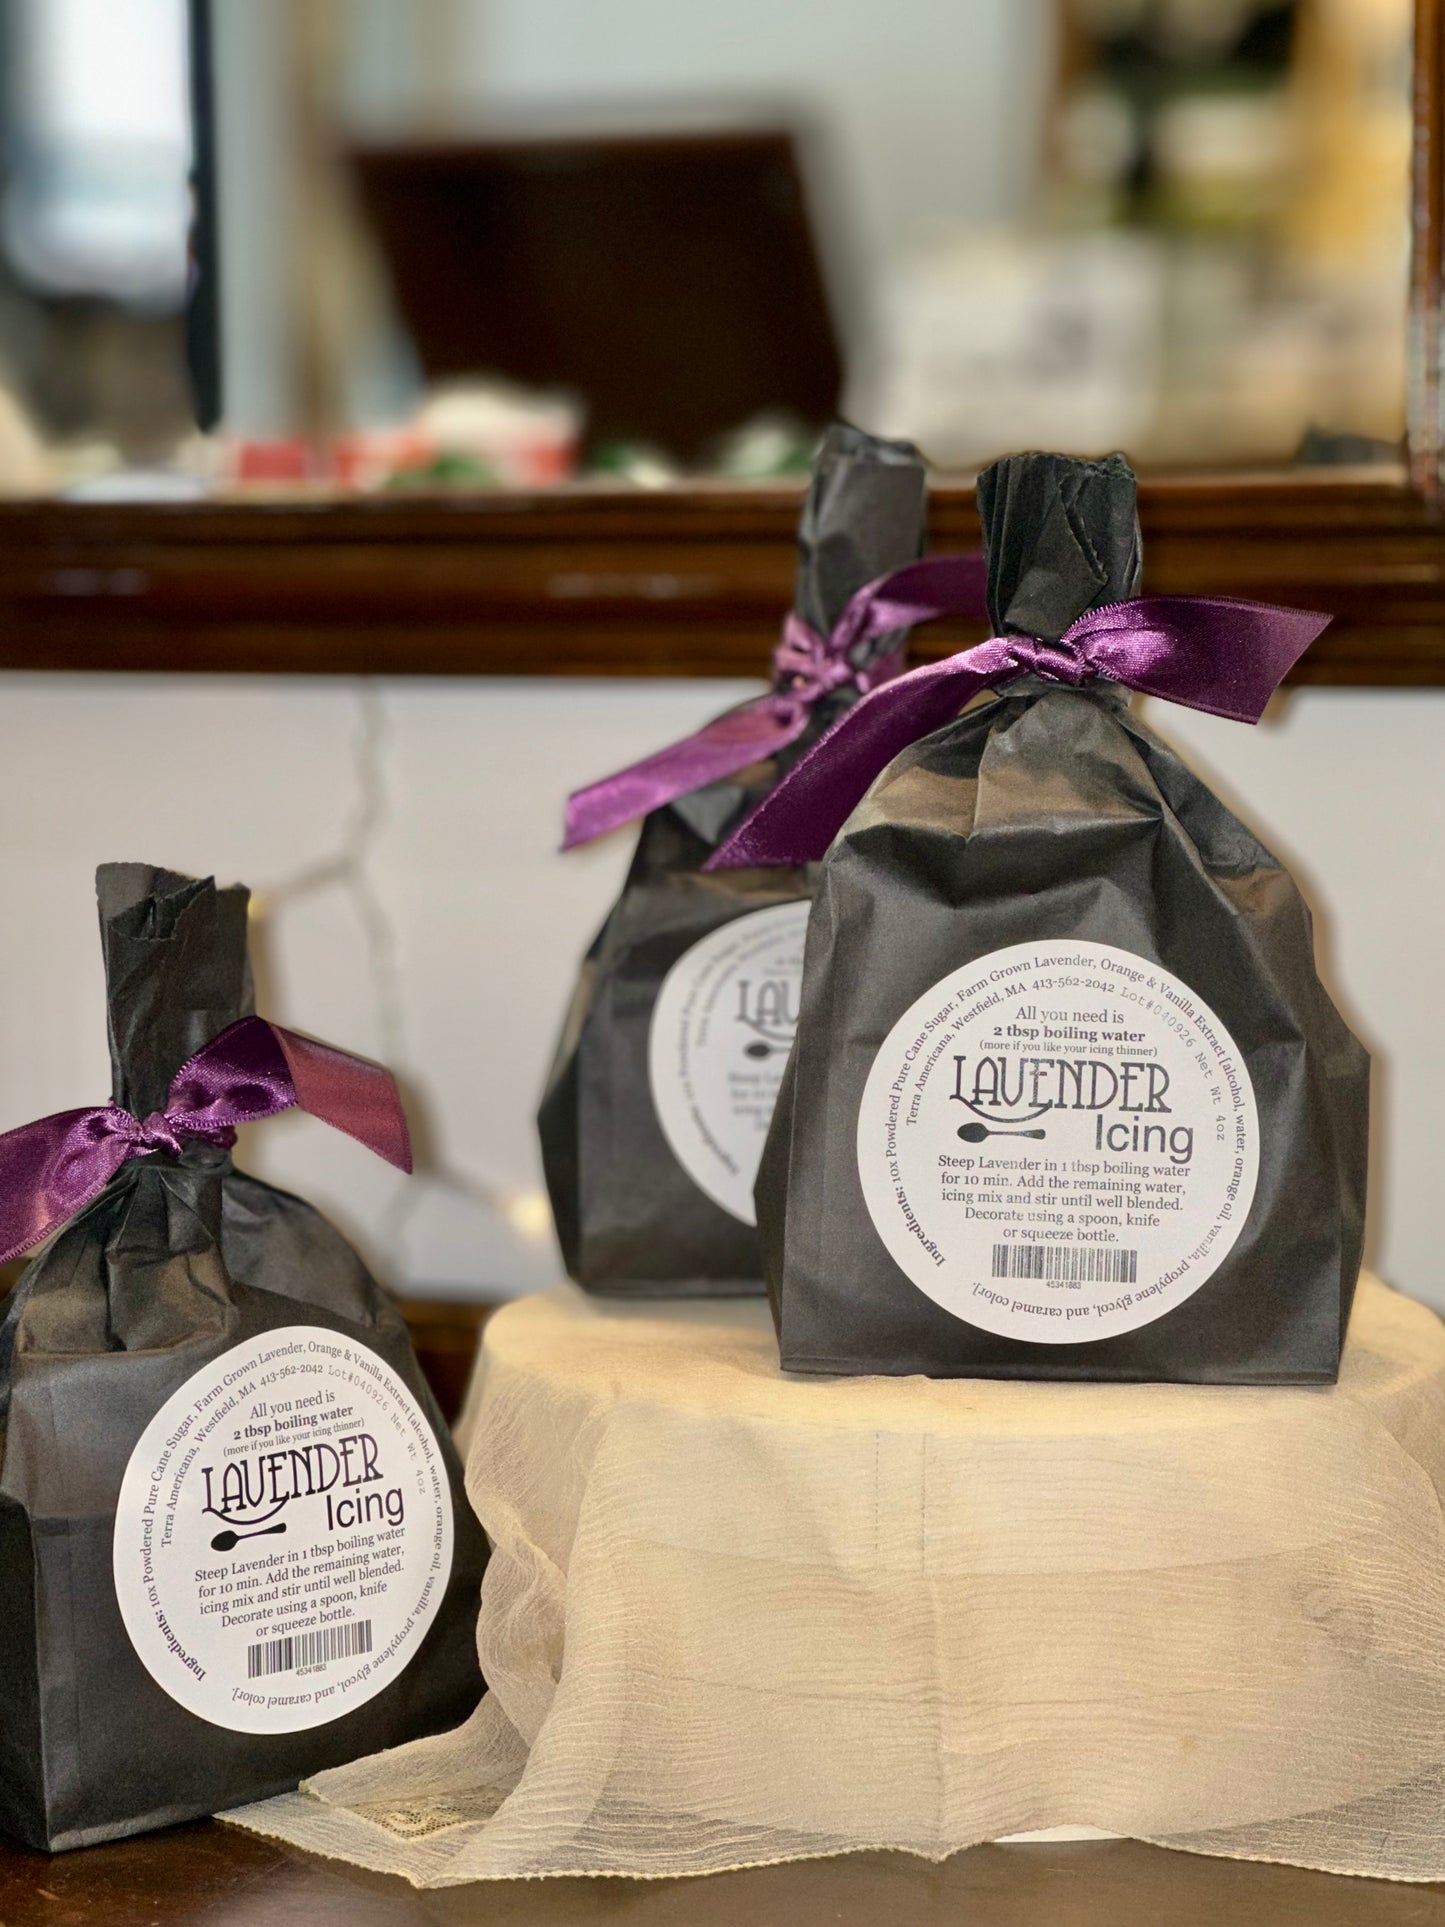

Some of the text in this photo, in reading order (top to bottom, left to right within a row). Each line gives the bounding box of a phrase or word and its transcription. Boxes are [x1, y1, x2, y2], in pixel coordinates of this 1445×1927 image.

[990, 962, 1031, 982] Grown
[1034, 955, 1096, 968] Lavender,
[1101, 958, 1145, 983] Orange
[957, 979, 989, 1002] Farm
[1146, 977, 1157, 989] &
[1016, 1006, 1124, 1024] All you need is
[1160, 983, 1194, 1018] Vanilla
[924, 1001, 959, 1032] Sugar,
[905, 1031, 928, 1061] Cane
[980, 1040, 1158, 1057] (more if you like your icing thinner)
[994, 1025, 1145, 1043] 2 tbsp boiling water
[1194, 1014, 1226, 1058] Extract
[906, 1092, 921, 1126] Terra
[914, 1033, 955, 1092] Americana,
[951, 992, 1004, 1031] Westfield,
[1005, 982, 1027, 997] MA
[1032, 976, 1115, 992] 413-562-2042
[1195, 1052, 1212, 1079] Net
[1210, 1086, 1222, 1105] Wt
[892, 1063, 911, 1091] Pure
[950, 1056, 1172, 1123] LAVENDER
[885, 1094, 899, 1158] Powdered
[1096, 1114, 1193, 1164] Icing
[1235, 1114, 1247, 1154] water,
[938, 1155, 974, 1170] Steep
[979, 1156, 1041, 1171] Lavender
[1044, 1159, 1057, 1171] in
[1071, 1160, 1100, 1175] tbsp
[1104, 1161, 1149, 1177] boiling
[1153, 1166, 1191, 1176] water
[1227, 1158, 1244, 1201] orange
[941, 1172, 960, 1184] for
[983, 1176, 1012, 1186] min.
[1017, 1176, 1044, 1187] Add
[1048, 1176, 1069, 1188] the
[1073, 1179, 1141, 1194] remaining
[1145, 1183, 1186, 1195] water,
[942, 1189, 1183, 1210] icing mix and stir until well blended.
[1216, 1203, 1232, 1221] oil,
[896, 1186, 946, 1267] Ingredients:
[965, 1207, 1160, 1226] Decorate using a spoon, knife
[1003, 1229, 1119, 1242] or squeeze bottle.
[1188, 1225, 1222, 1260] vanilla,
[1135, 1260, 1190, 1298] propylene
[1010, 1302, 1062, 1316] caramel
[1066, 1307, 1090, 1320] and
[1092, 1295, 1133, 1317] glycol,
[258, 1343, 306, 1364] Lavender,
[308, 1341, 342, 1358] Orange
[344, 1350, 352, 1360] &
[222, 1360, 258, 1386] Grown
[260, 1364, 323, 1386] 413-562-2042
[354, 1353, 383, 1381] Vanilla
[194, 1386, 223, 1412] Farm
[239, 1382, 257, 1399] MA
[250, 1391, 335, 1419] All you need is
[383, 1378, 411, 1415] Extract
[167, 1414, 199, 1450] Sugar,
[194, 1397, 240, 1443] Westfield,
[233, 1406, 354, 1440] 2 tbsp boiling water
[391, 1413, 406, 1437] Net
[223, 1417, 365, 1457] (more if you like your icing thinner)
[407, 1442, 417, 1461] Wt
[151, 1450, 172, 1482] Cane
[166, 1447, 200, 1510] Americana,
[202, 1433, 384, 1525] LAVENDER
[430, 1464, 442, 1504] water,
[144, 1485, 159, 1514] Pure
[326, 1488, 404, 1530] Icing
[161, 1514, 174, 1548] Terra
[434, 1506, 443, 1550] orange
[140, 1519, 154, 1584] Powdered
[195, 1527, 406, 1582] Steep Lavender in 1 tbsp boiling water
[430, 1553, 441, 1572] oil,
[199, 1544, 405, 1598] for 10 min. Add the remaining water,
[200, 1560, 404, 1615] icing mix and stir until well blended.
[412, 1576, 435, 1616] vanilla,
[222, 1581, 387, 1627] Decorate using a spoon, knife
[256, 1606, 355, 1637] or squeeze bottle.
[155, 1609, 207, 1681] Ingredients:
[373, 1618, 415, 1668] propylene
[337, 1664, 371, 1688] glycol,
[267, 1694, 312, 1709] caramel
[315, 1685, 335, 1703] and
